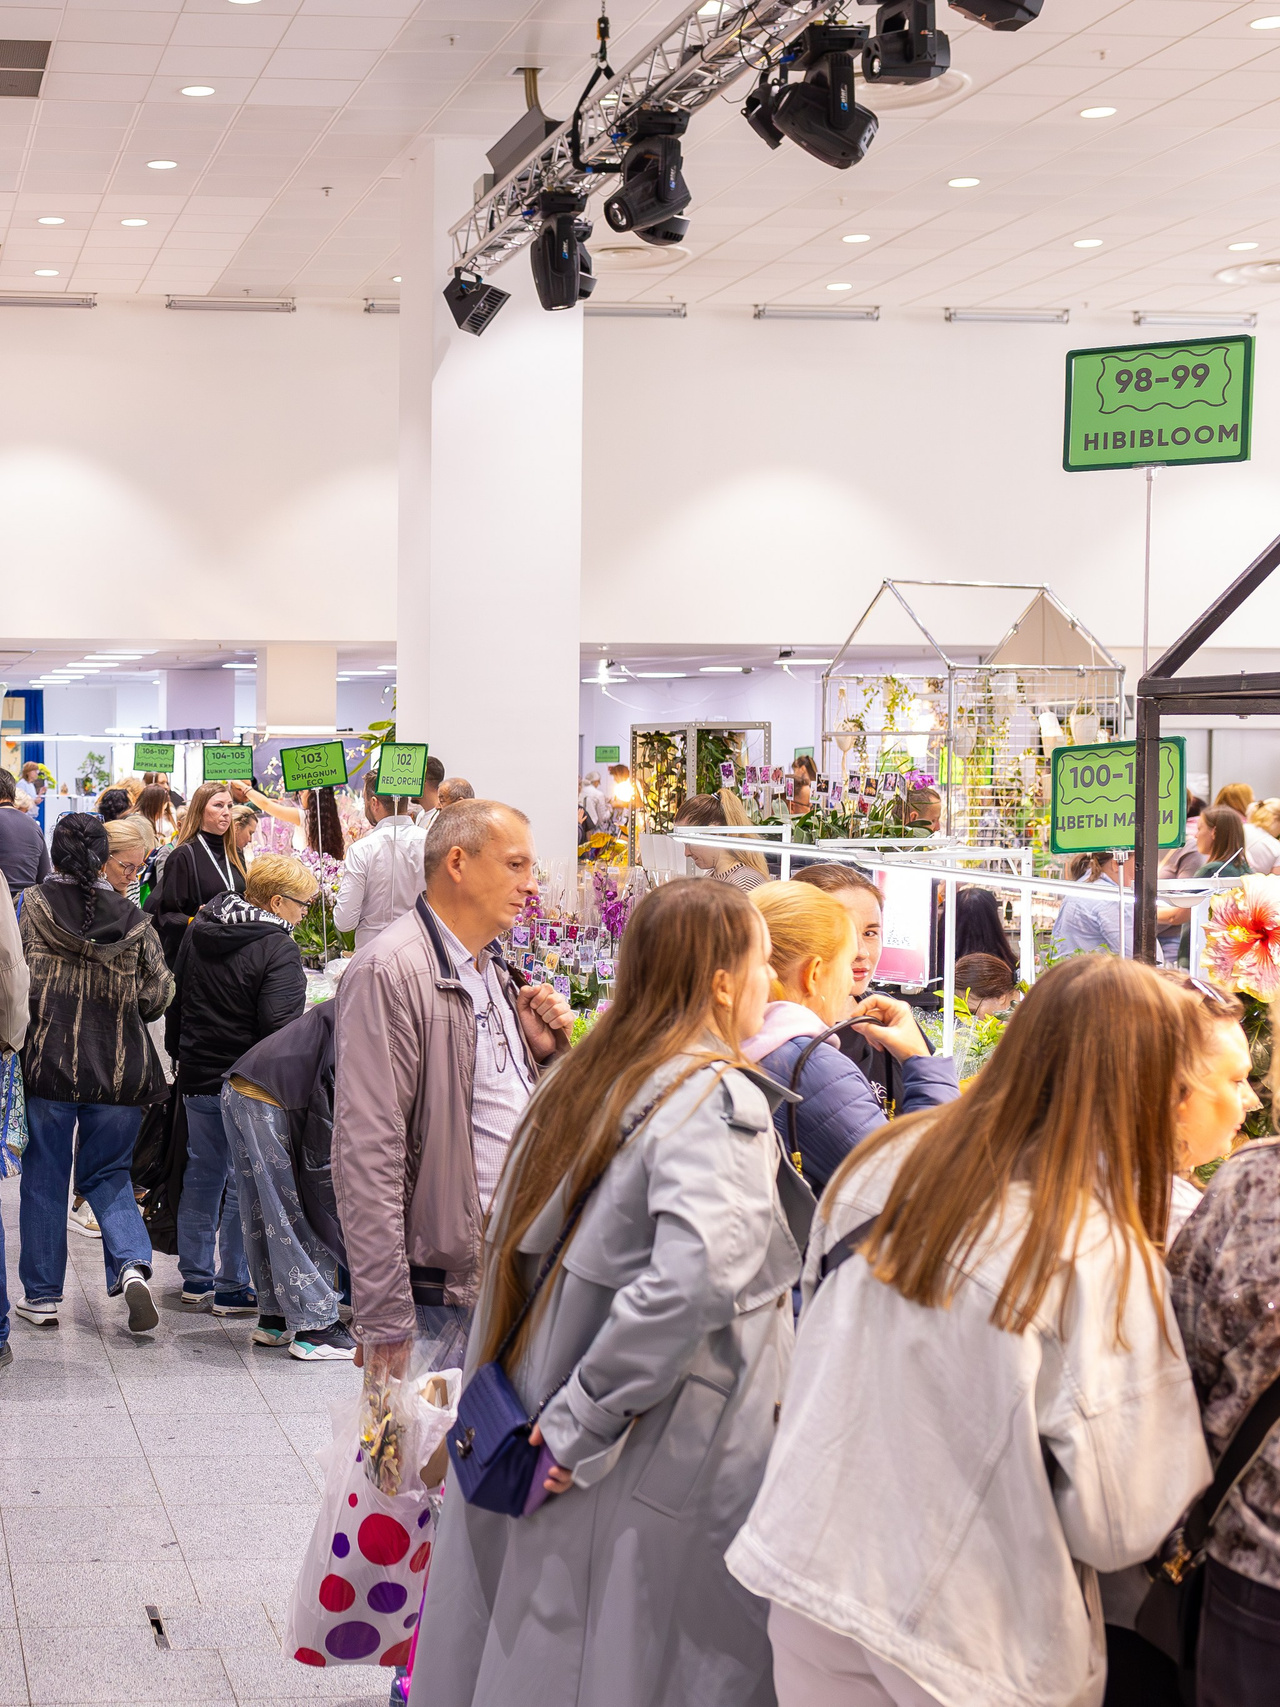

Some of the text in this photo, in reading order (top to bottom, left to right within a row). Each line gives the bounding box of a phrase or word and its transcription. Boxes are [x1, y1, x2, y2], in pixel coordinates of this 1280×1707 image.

[1115, 363, 1210, 394] 98-99
[1083, 423, 1239, 451] HIBIBLOOM
[142, 747, 169, 755] 106-107
[212, 752, 245, 760] 104-105
[301, 752, 322, 764] 103
[396, 753, 411, 766] 102
[291, 768, 337, 782] SPHAGNUM
[1069, 762, 1135, 789] 100-1
[306, 778, 324, 786] ECO
[1056, 813, 1108, 833] ЦВЕТЫ
